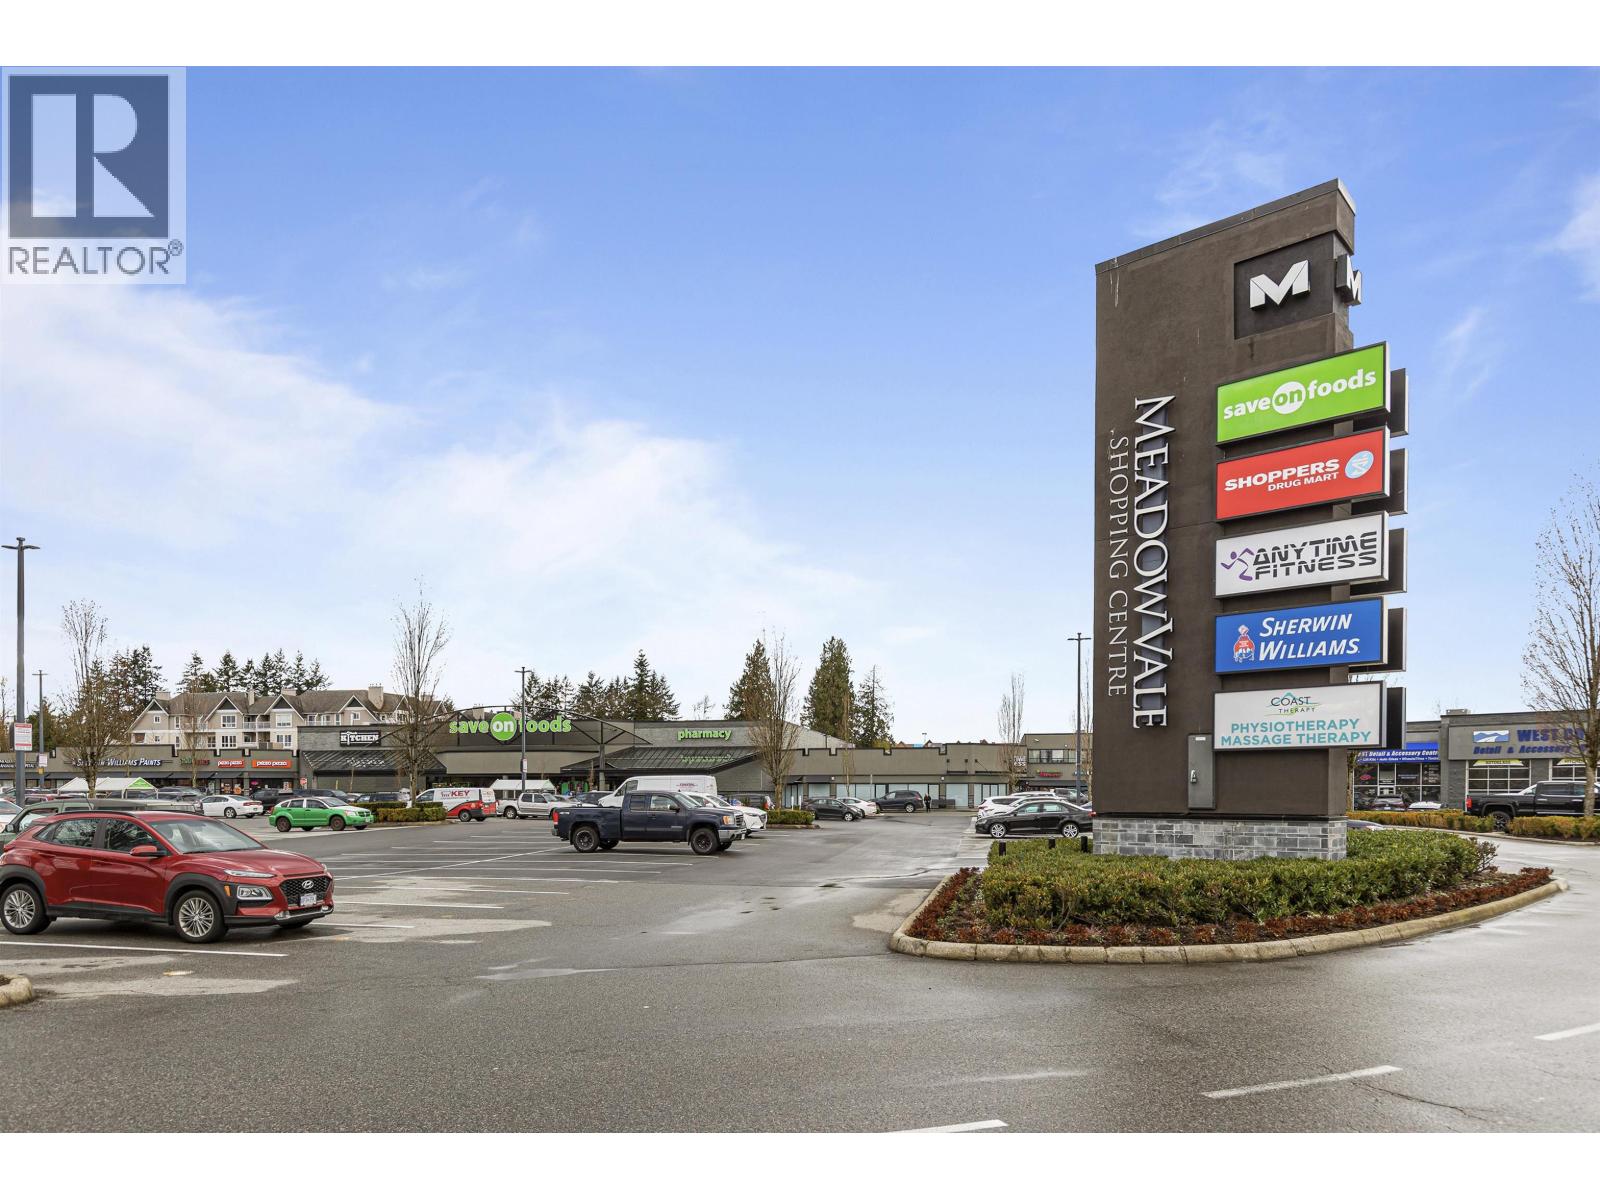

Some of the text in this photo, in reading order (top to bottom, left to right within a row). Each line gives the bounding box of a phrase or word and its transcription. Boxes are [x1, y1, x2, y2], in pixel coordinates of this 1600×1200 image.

[1250, 259, 1309, 309] M
[1223, 368, 1377, 420] save on foods
[1224, 458, 1340, 491] SHOPPERS
[1267, 472, 1339, 492] DRUG MART
[1253, 530, 1377, 566] ANYTIME
[1108, 435, 1129, 697] SHOPPING CENTRE
[1133, 395, 1176, 729] MEADOWVALE
[1255, 550, 1377, 581] FITNESS
[1259, 613, 1353, 638] SHERWIN
[1270, 696, 1312, 707] COAST
[449, 720, 489, 734] save
[492, 720, 514, 733] on
[1231, 718, 1360, 733] PHYSIOTHERAPY
[341, 733, 379, 743] KITCHEN
[677, 728, 732, 741] pharmacy
[1221, 731, 1371, 746] MASSAGE THERAPY
[1516, 728, 1559, 742] WEST
[1473, 746, 1502, 755] Detail
[139, 758, 161, 766] PAINTS
